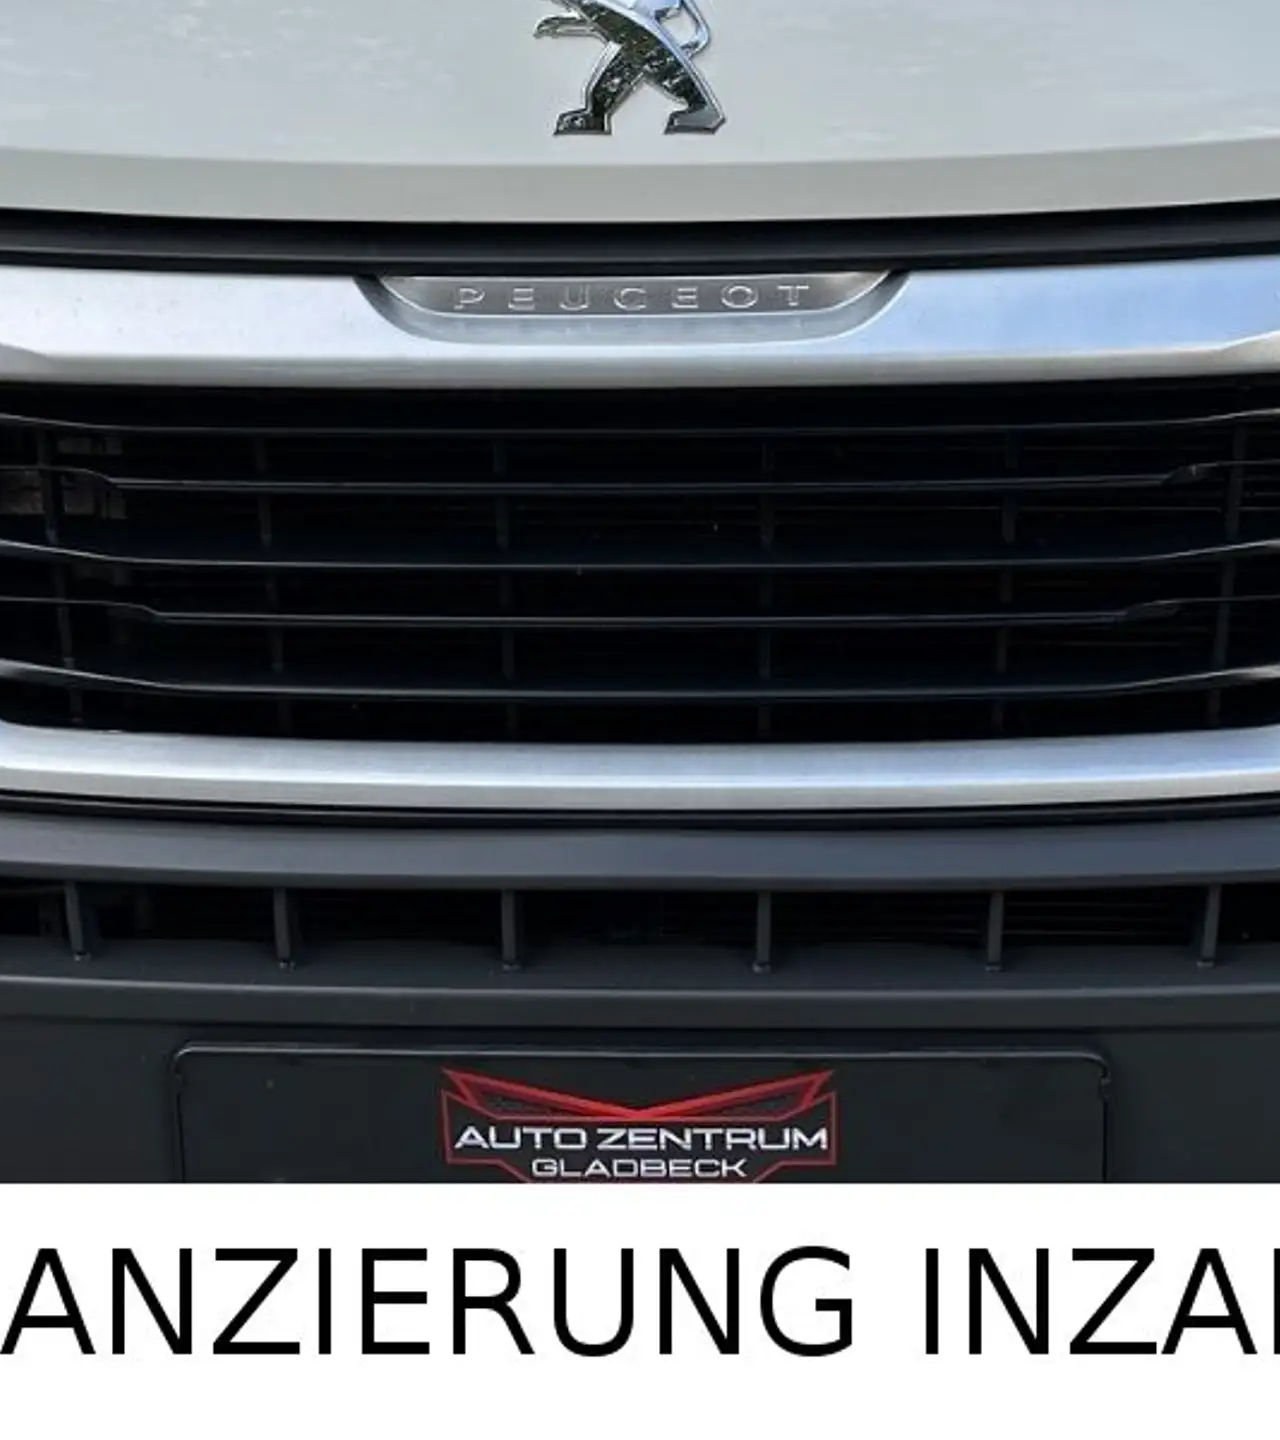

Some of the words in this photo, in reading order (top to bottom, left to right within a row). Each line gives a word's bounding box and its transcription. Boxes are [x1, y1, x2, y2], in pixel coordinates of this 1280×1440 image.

[453, 284, 811, 312] PEUGEOT
[454, 1125, 588, 1151] AUTO
[596, 1126, 830, 1152] ZENTRUM
[531, 1157, 747, 1179] GLADBECK
